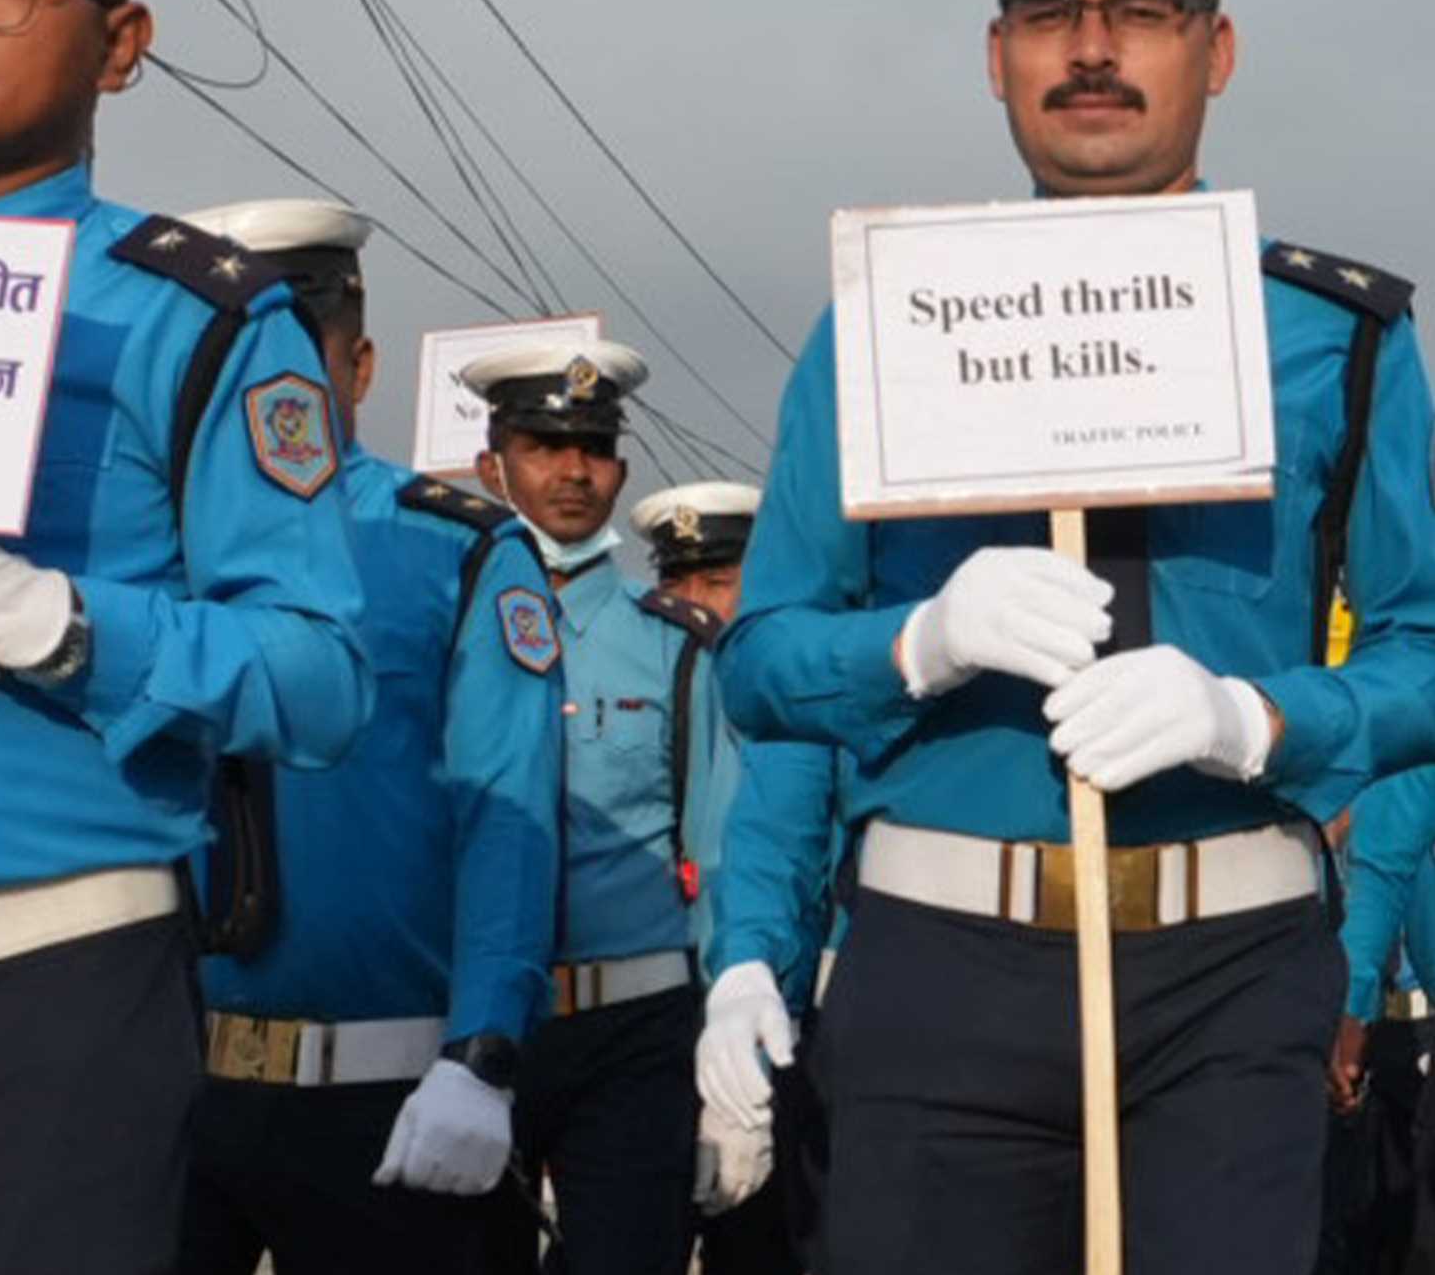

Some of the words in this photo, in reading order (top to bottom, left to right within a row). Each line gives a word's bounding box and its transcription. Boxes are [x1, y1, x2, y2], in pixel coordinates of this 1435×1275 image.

[908, 282, 1045, 334] Speed
[1061, 274, 1196, 317] thrills
[957, 347, 1036, 387] but
[1052, 427, 1127, 445] TRAFFIC
[1135, 422, 1205, 441] POLICE
